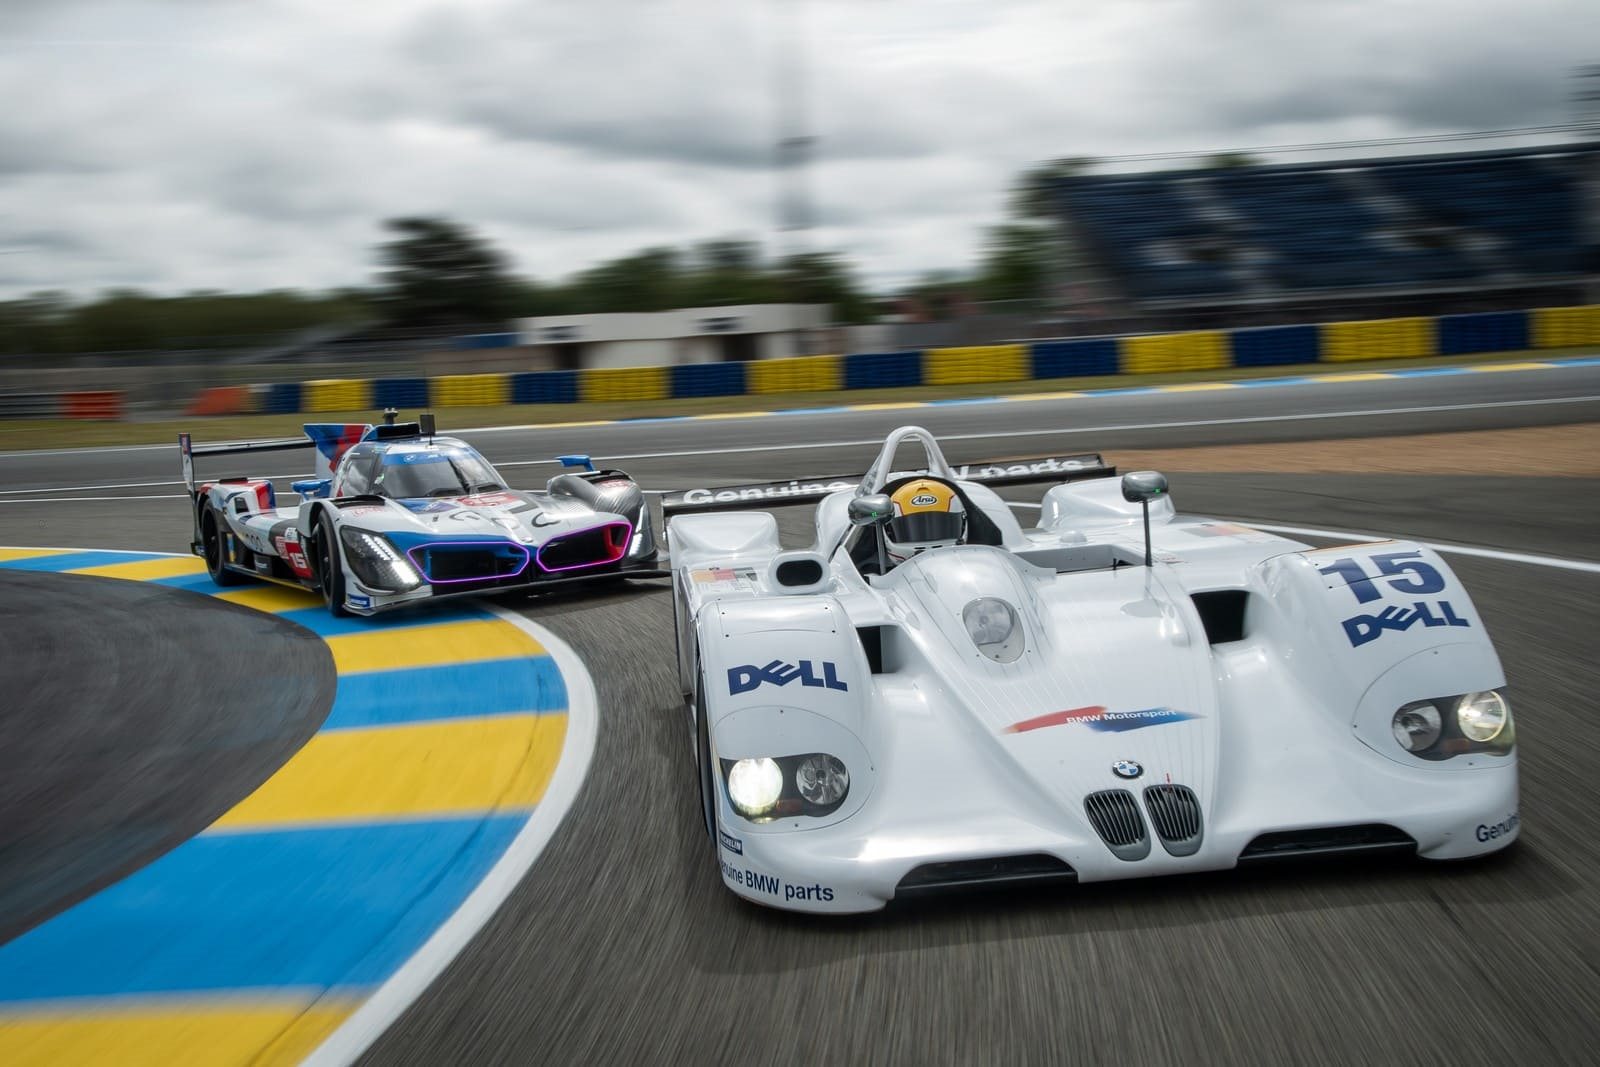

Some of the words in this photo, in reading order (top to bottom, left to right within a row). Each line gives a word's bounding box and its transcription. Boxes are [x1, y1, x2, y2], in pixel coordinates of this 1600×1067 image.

[684, 480, 850, 504] Genuine
[979, 458, 1083, 478] parts
[1318, 551, 1446, 605] 15
[1341, 601, 1471, 648] DELL
[727, 659, 848, 696] DELL
[1066, 714, 1101, 724] BMW
[1102, 709, 1177, 721] Motorsport
[721, 861, 744, 885] enuine
[745, 869, 780, 896] BMW
[785, 883, 835, 902] parts
